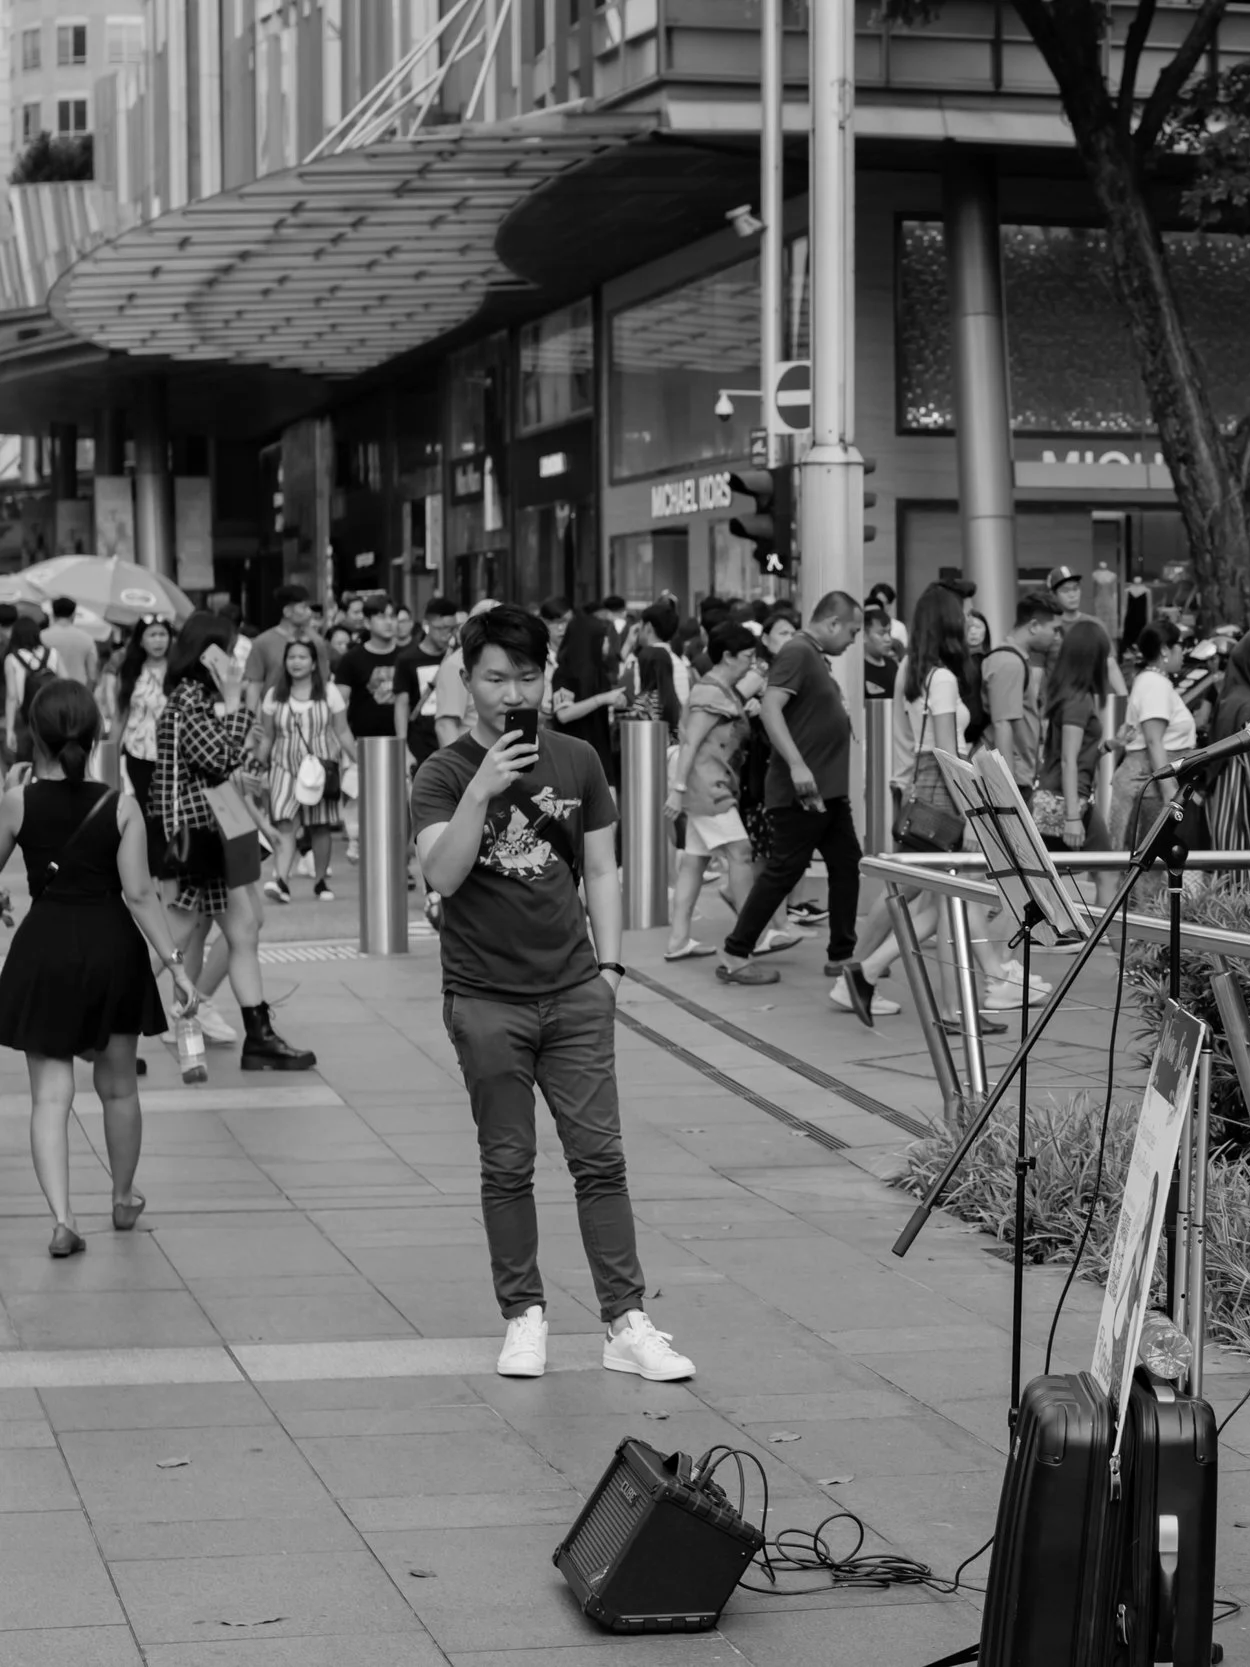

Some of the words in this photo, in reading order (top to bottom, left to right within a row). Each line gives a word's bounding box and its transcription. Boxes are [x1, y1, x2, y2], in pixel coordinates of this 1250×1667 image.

[652, 478, 698, 518] MICHAEL
[699, 472, 732, 510] KORS
[620, 1480, 637, 1504] CUBE
